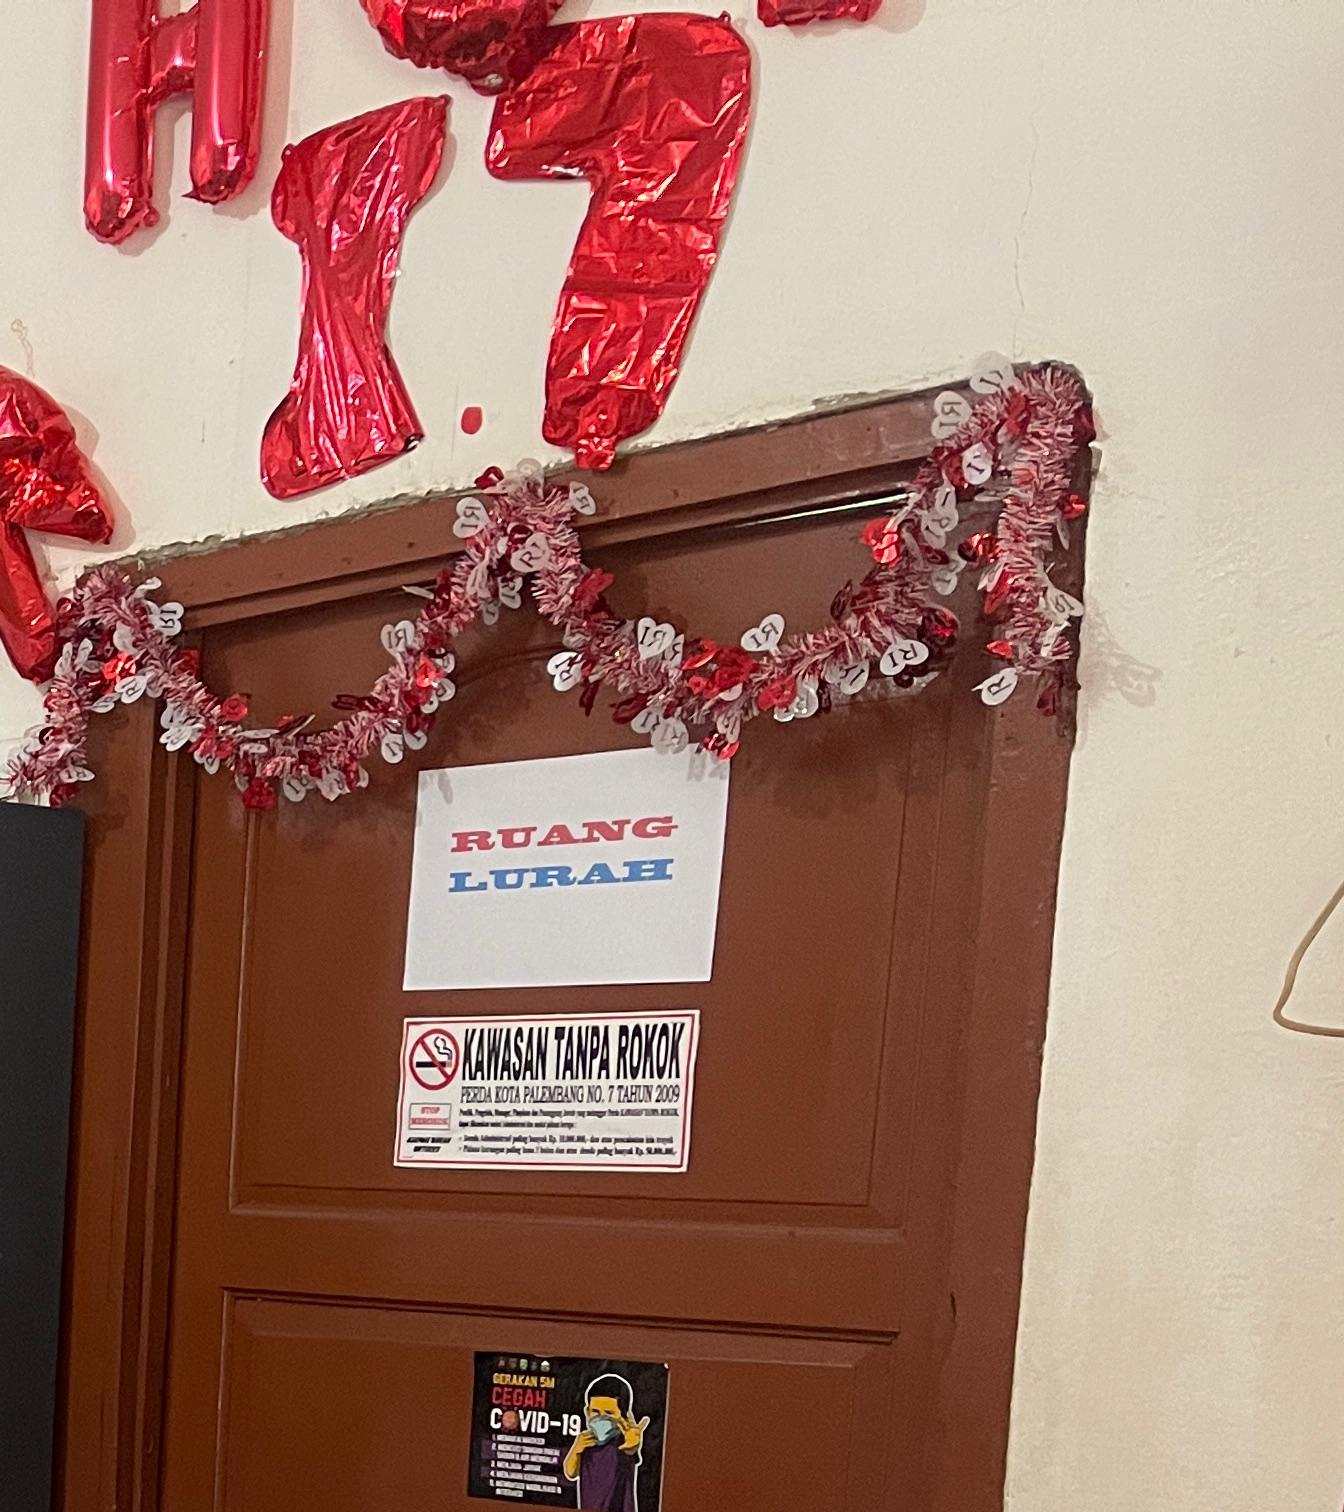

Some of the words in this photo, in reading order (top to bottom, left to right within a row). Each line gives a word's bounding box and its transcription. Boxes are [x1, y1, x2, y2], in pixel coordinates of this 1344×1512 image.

[451, 816, 679, 853] RUANG
[449, 858, 675, 893] LURAH
[462, 1027, 550, 1081] KAWASAN
[554, 1025, 610, 1080] TANPA
[616, 1022, 685, 1080] ROKOK
[460, 1085, 492, 1103] PERDA
[494, 1085, 520, 1103] KOTA
[523, 1085, 584, 1103] PALEMBANG
[586, 1085, 605, 1103] NO.
[608, 1085, 615, 1103] 7
[617, 1084, 653, 1103] TAHUN
[655, 1084, 681, 1103] 2009
[492, 1372, 538, 1388] GERAKAN
[491, 1387, 547, 1409] CEGAH
